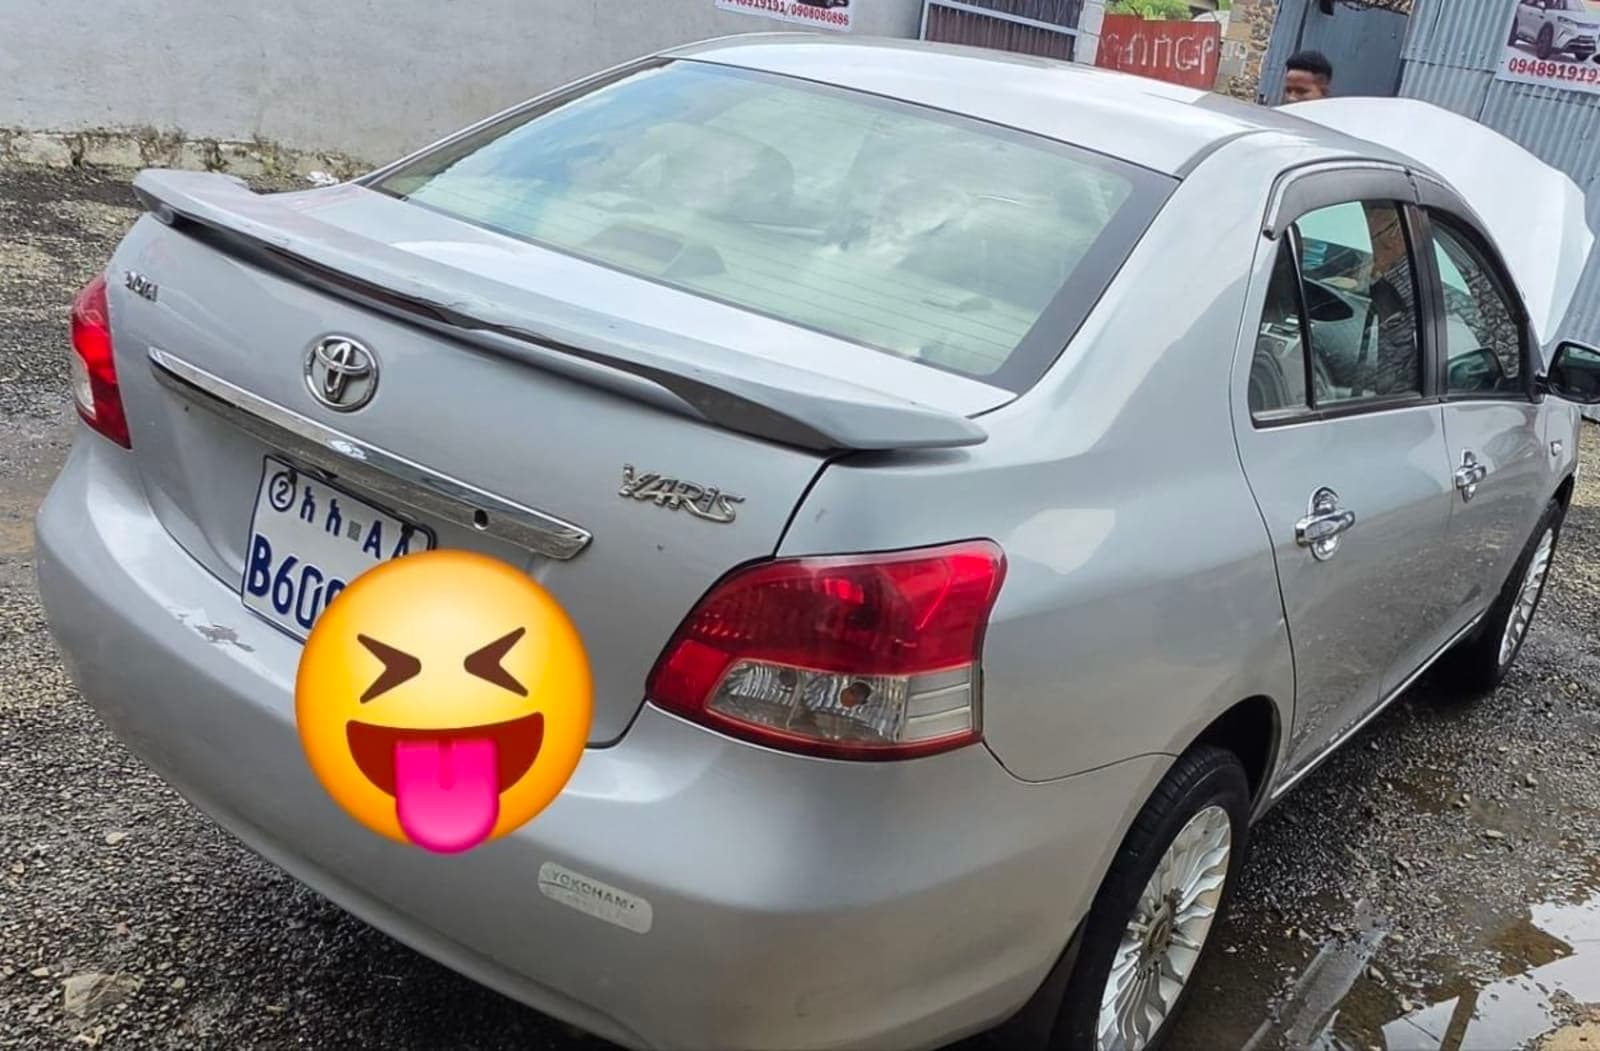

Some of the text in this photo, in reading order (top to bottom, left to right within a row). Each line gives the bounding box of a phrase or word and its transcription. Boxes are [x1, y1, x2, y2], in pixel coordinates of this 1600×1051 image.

[1508, 57, 1600, 84] 094891919
[619, 464, 746, 524] YARIS
[552, 870, 636, 910] YOKOHAM
